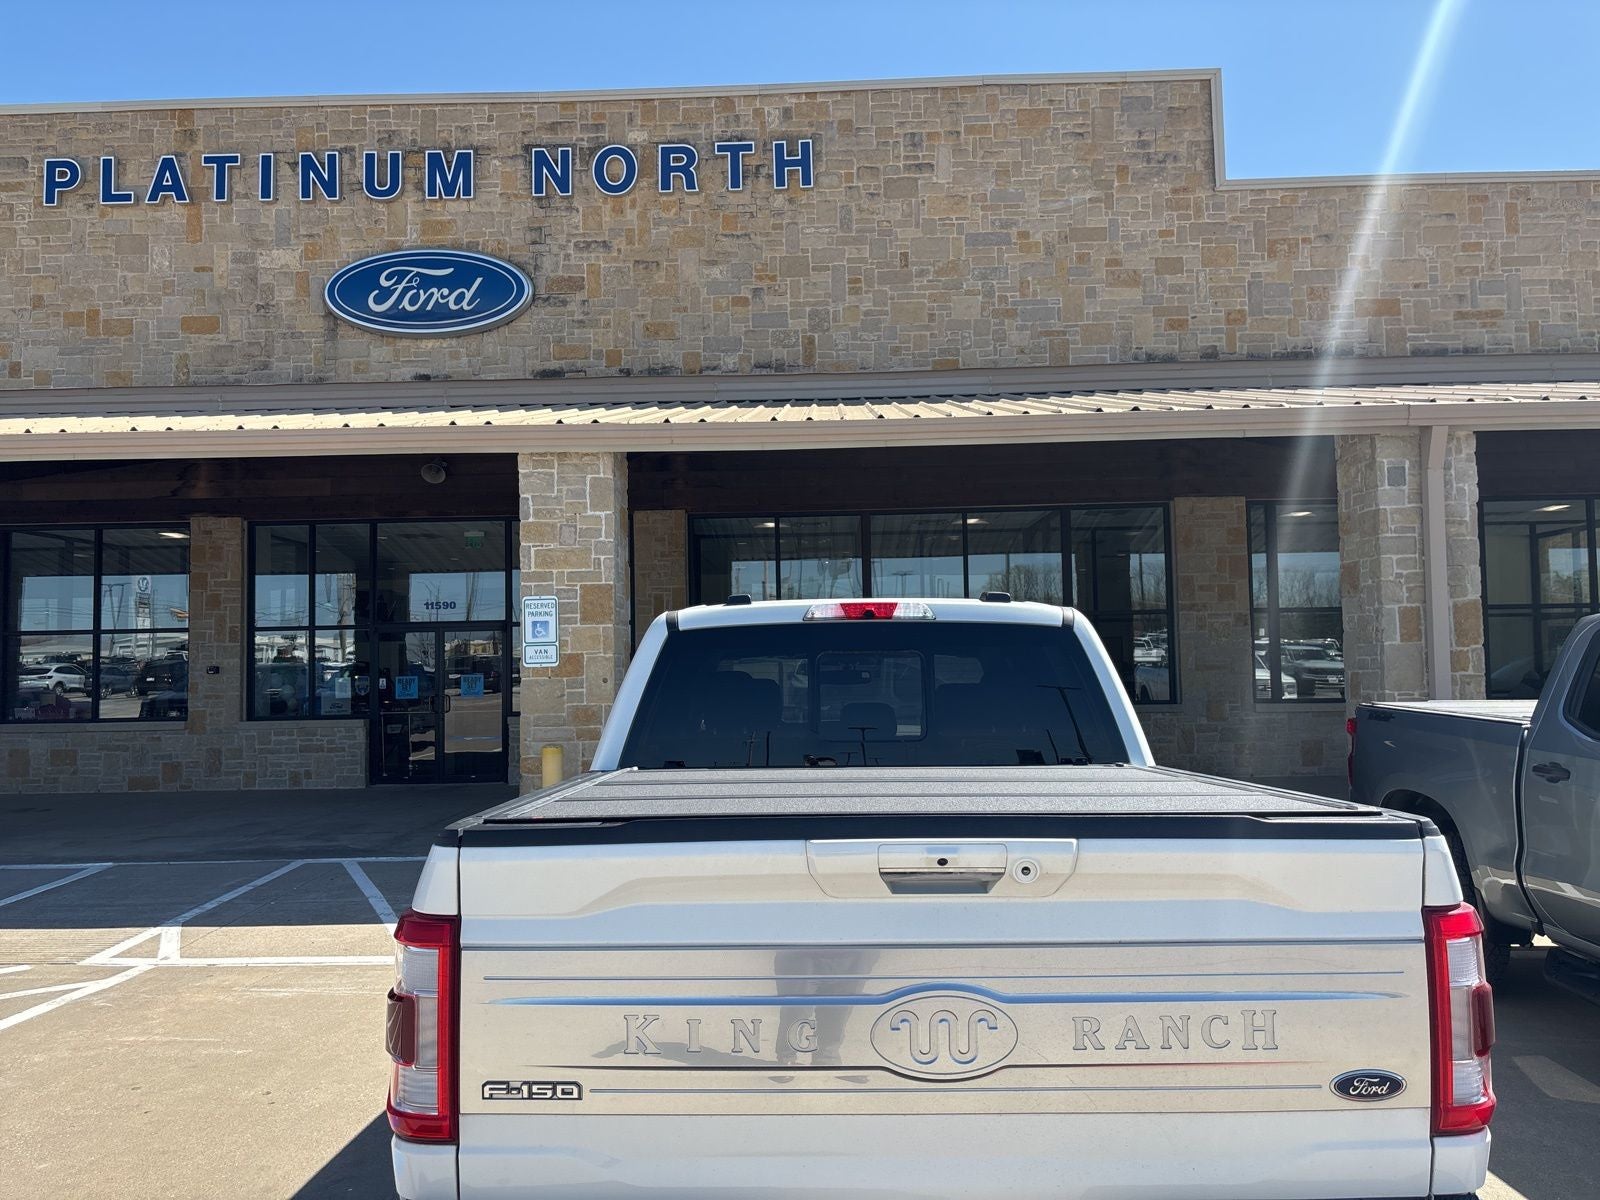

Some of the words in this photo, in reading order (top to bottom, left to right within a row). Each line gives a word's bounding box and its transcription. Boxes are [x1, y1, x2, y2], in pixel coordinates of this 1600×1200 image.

[43, 149, 475, 207] PLATINUM
[531, 138, 815, 197] NORTH
[367, 266, 484, 313] Ford
[424, 601, 456, 610] 11590
[623, 1014, 819, 1056] KING
[1072, 1008, 1281, 1052] RANCH
[482, 1080, 583, 1101] F-150
[1349, 1077, 1390, 1095] Ford
